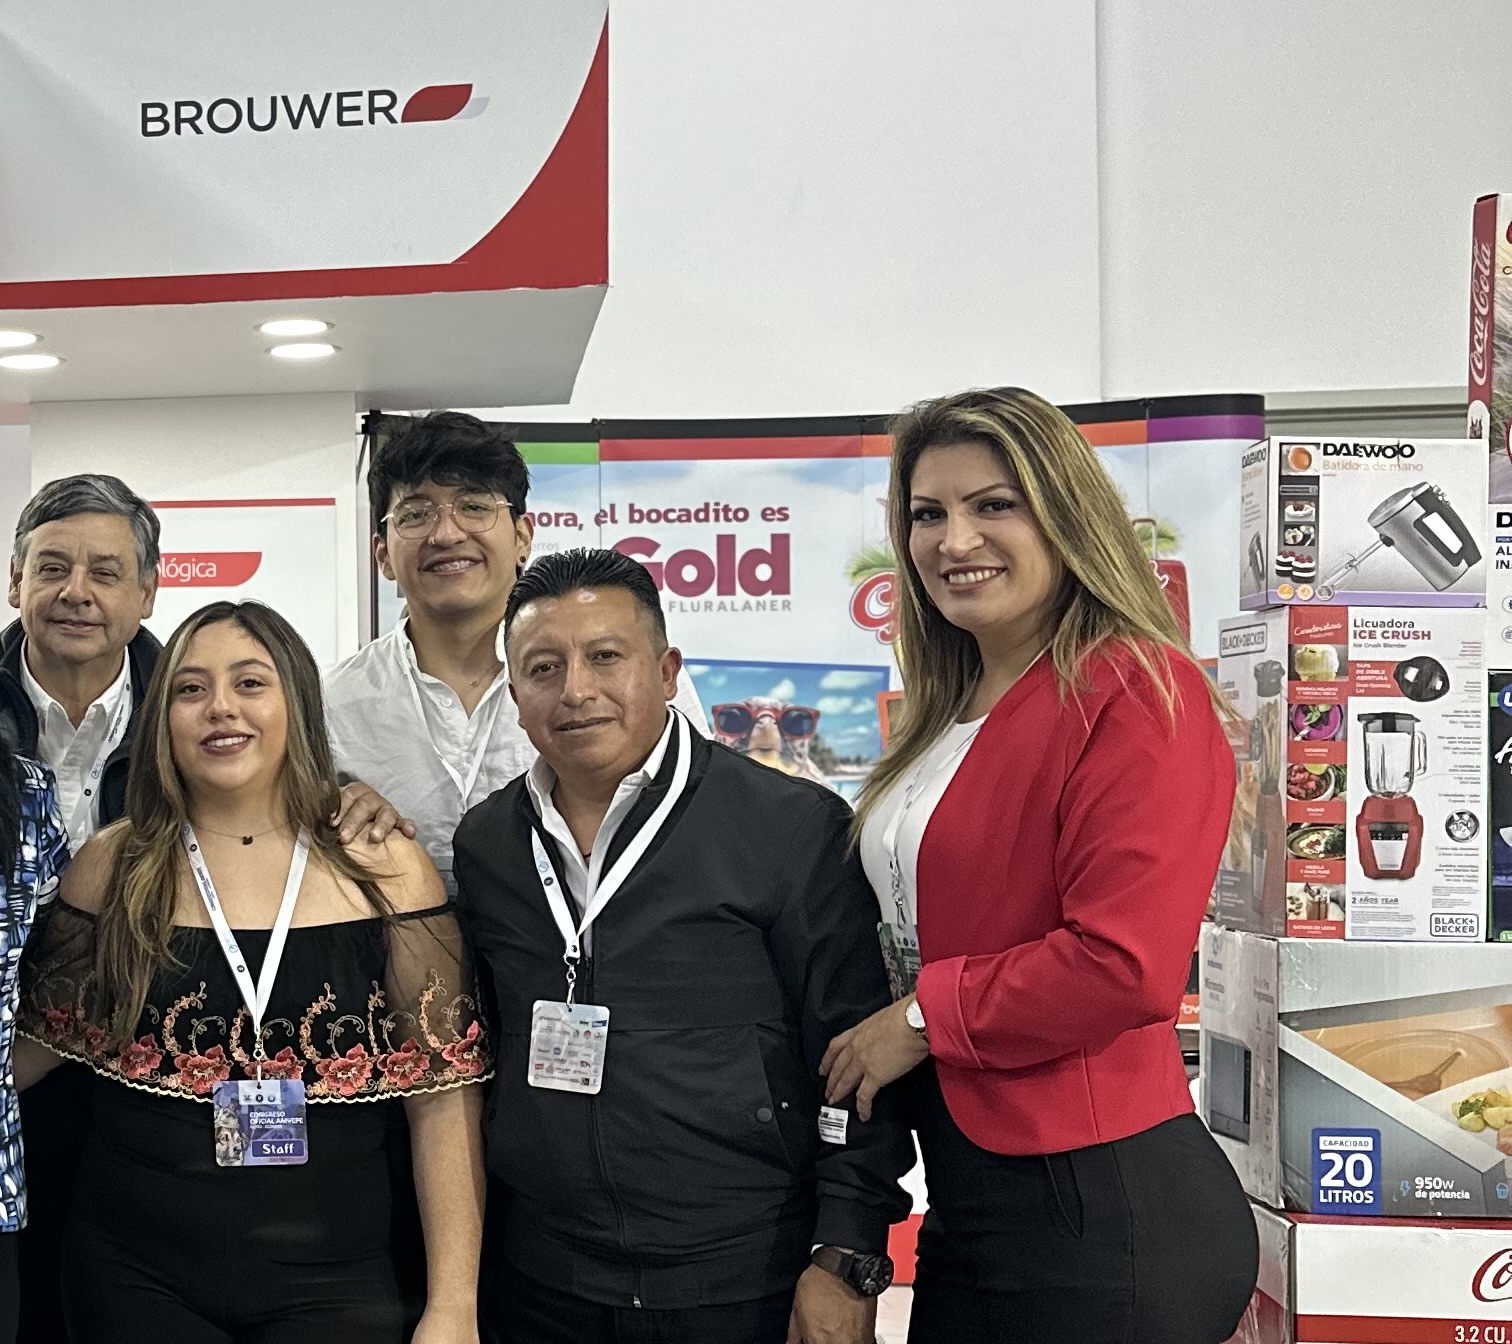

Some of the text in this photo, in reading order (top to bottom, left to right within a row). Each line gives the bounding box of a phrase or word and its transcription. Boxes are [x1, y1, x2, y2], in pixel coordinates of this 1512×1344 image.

[140, 89, 399, 138] BROUWER
[1322, 443, 1416, 459] DAEWOO
[1389, 463, 1424, 472] mano
[594, 503, 618, 525] el
[628, 502, 750, 524] bocadito
[760, 506, 790, 523] es
[531, 541, 560, 553] erros
[668, 599, 792, 613] FLURALANER
[1353, 618, 1415, 629] Licuadora
[1353, 630, 1432, 641] ICE CRUSH
[1434, 916, 1475, 925] BLACK+
[1434, 925, 1475, 934] DECKER
[262, 1142, 295, 1155] Staff
[1323, 1140, 1370, 1148] CAPACIDAD
[1320, 1153, 1374, 1188] 20
[1319, 1189, 1374, 1204] LITROS
[1415, 1189, 1470, 1200] de potencia
[1454, 1325, 1480, 1343] 3.2
